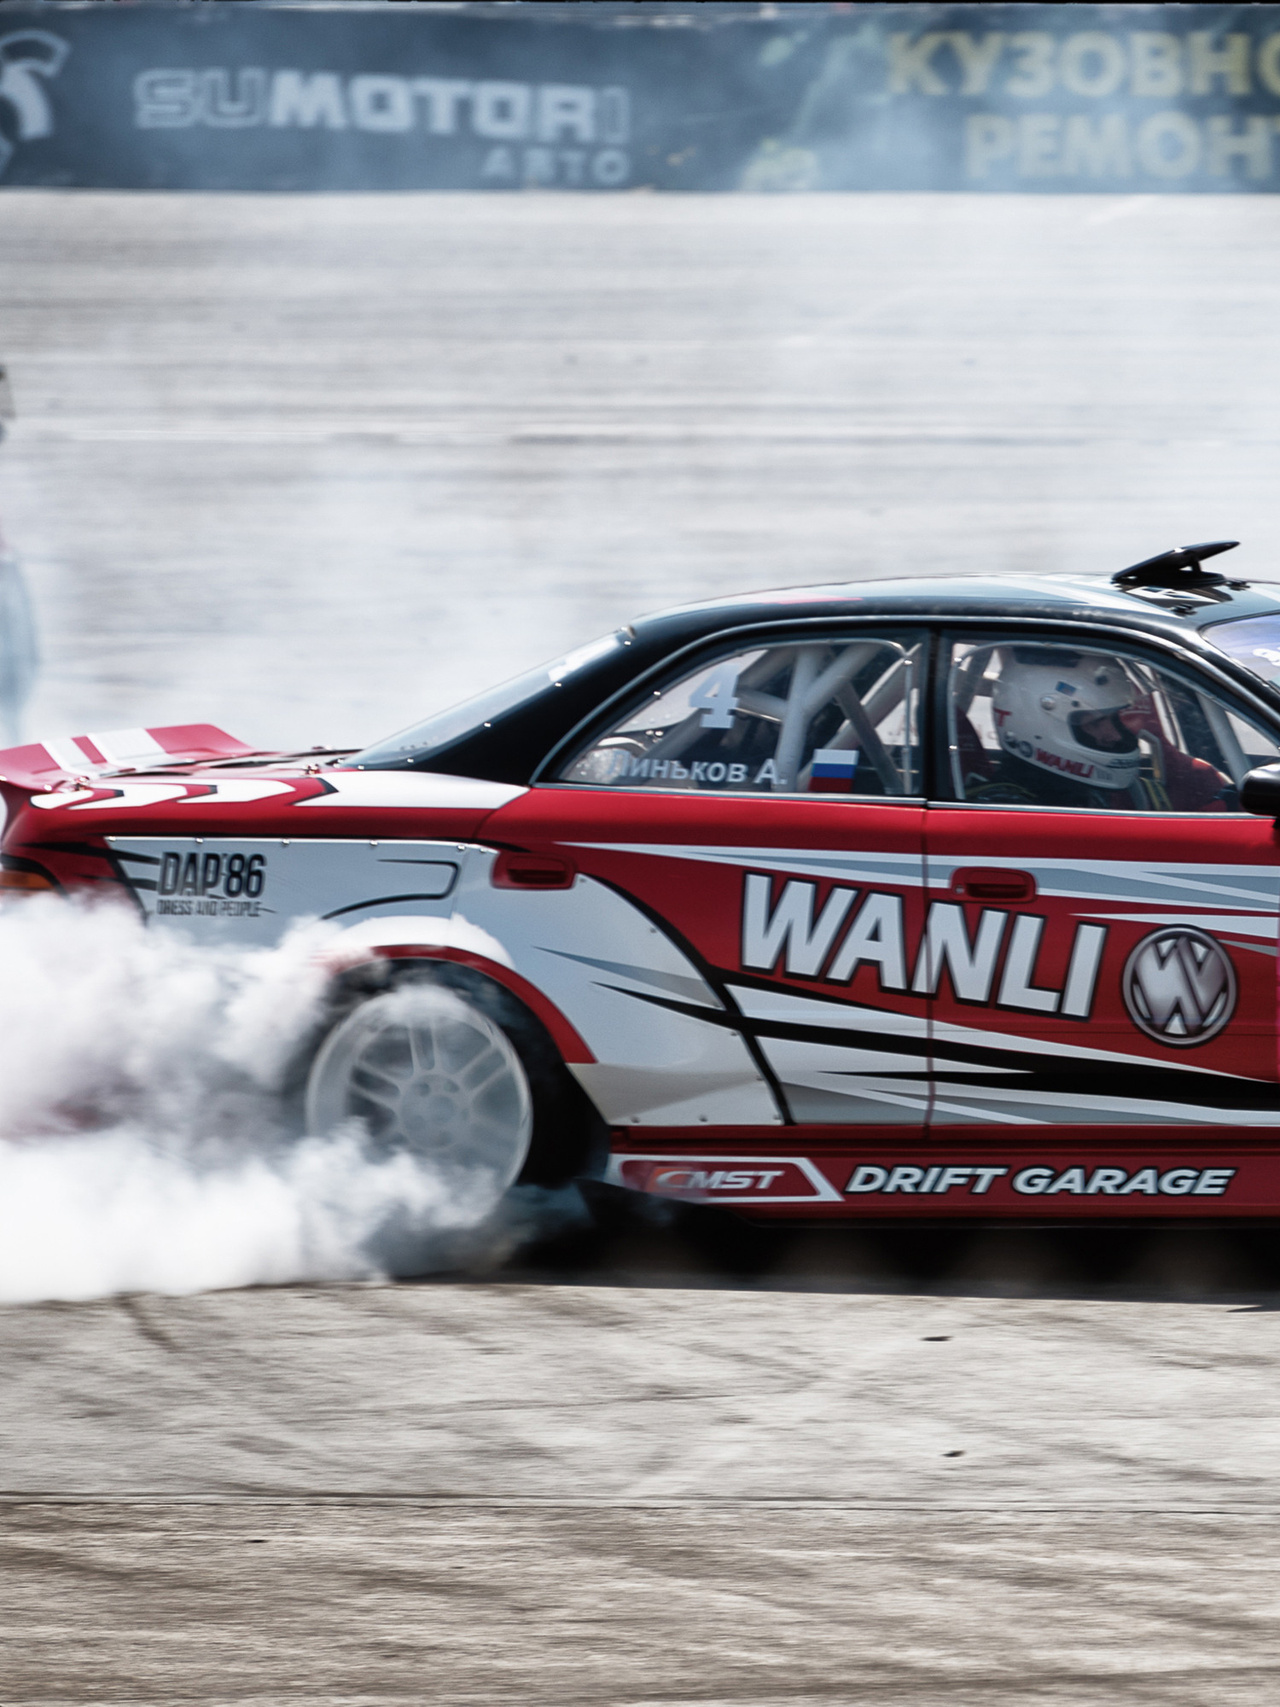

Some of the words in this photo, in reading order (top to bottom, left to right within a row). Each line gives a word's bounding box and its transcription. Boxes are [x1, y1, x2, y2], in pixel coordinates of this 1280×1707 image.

[132, 65, 630, 144] SUMOTORI
[480, 146, 630, 185] АВТО
[689, 663, 741, 729] 4
[1034, 747, 1095, 779] WANLI
[739, 870, 1109, 1024] WANLI
[655, 1167, 785, 1191] CMST
[844, 1165, 1008, 1195] DRIFT
[1011, 1166, 1237, 1196] GARAGE
